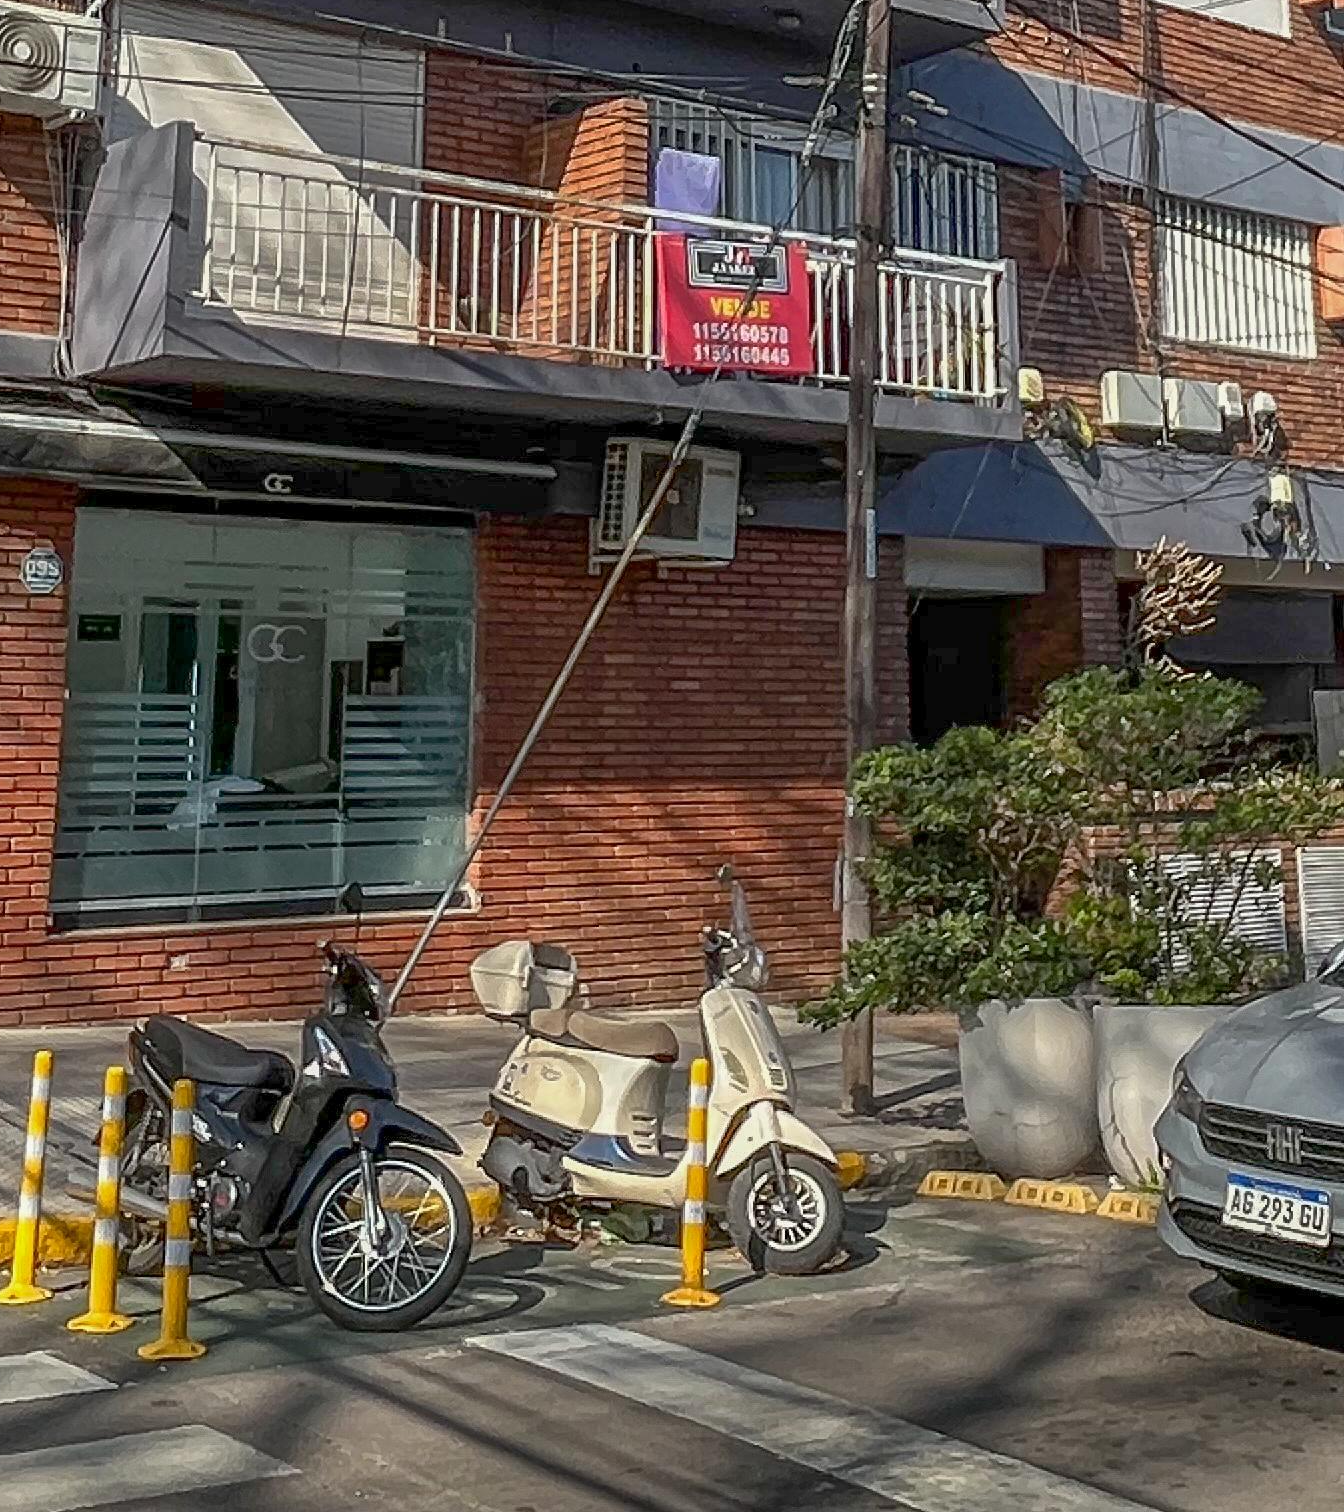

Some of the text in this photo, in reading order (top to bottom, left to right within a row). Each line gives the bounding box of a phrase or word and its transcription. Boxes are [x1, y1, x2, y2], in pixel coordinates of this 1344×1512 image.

[1230, 1188, 1254, 1215] AG
[1258, 1194, 1294, 1224] 293
[1299, 1204, 1324, 1231] GU
